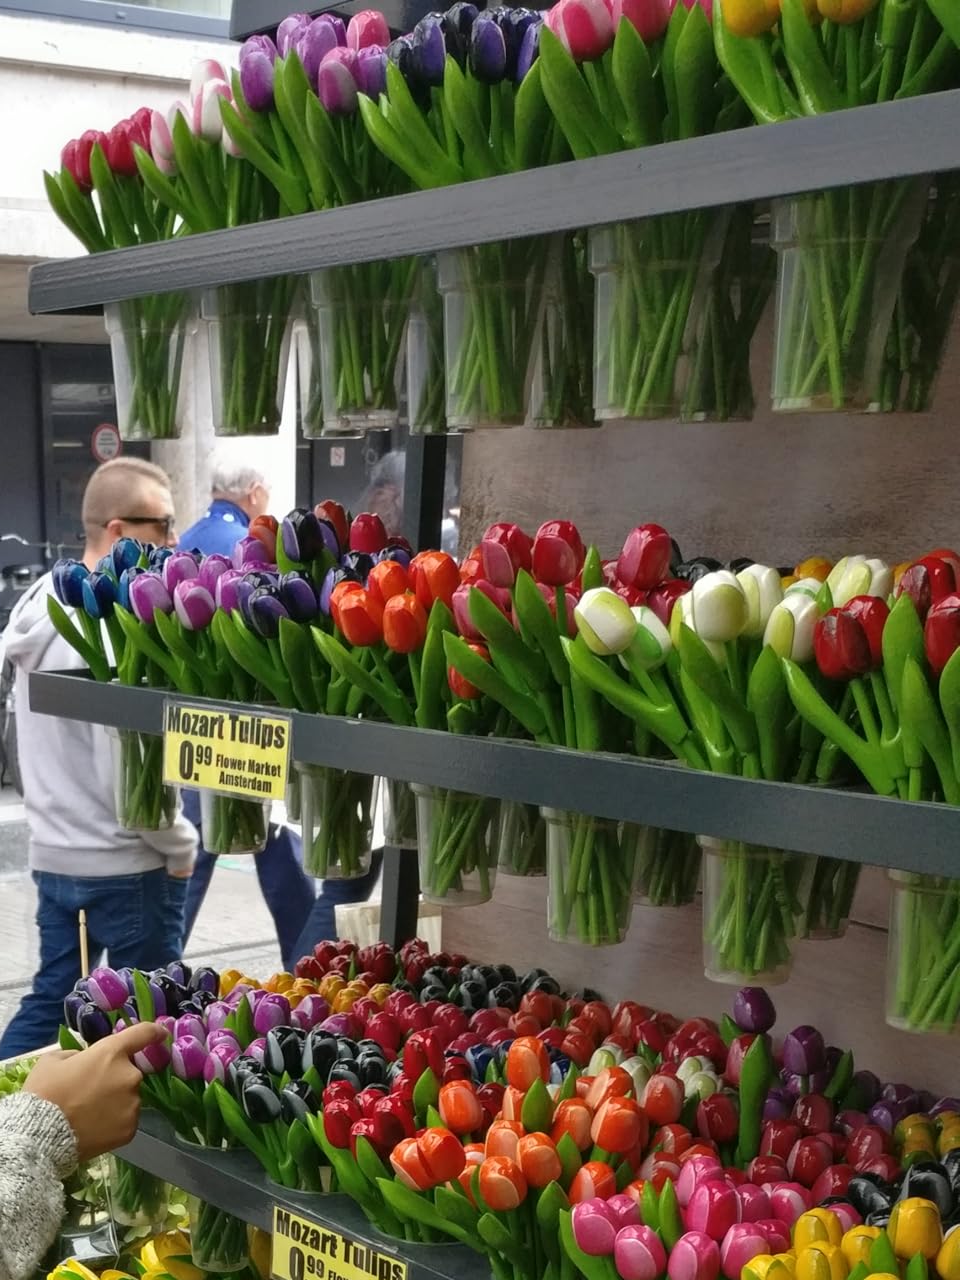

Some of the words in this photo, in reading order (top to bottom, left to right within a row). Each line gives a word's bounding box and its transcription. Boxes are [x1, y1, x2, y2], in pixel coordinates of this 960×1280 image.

[167, 706, 224, 740] Mozart
[229, 714, 285, 749] Tulips
[216, 754, 246, 771] Flower
[247, 759, 281, 777] Market
[219, 771, 272, 793] Amsterdam
[276, 1208, 337, 1258] Mozart
